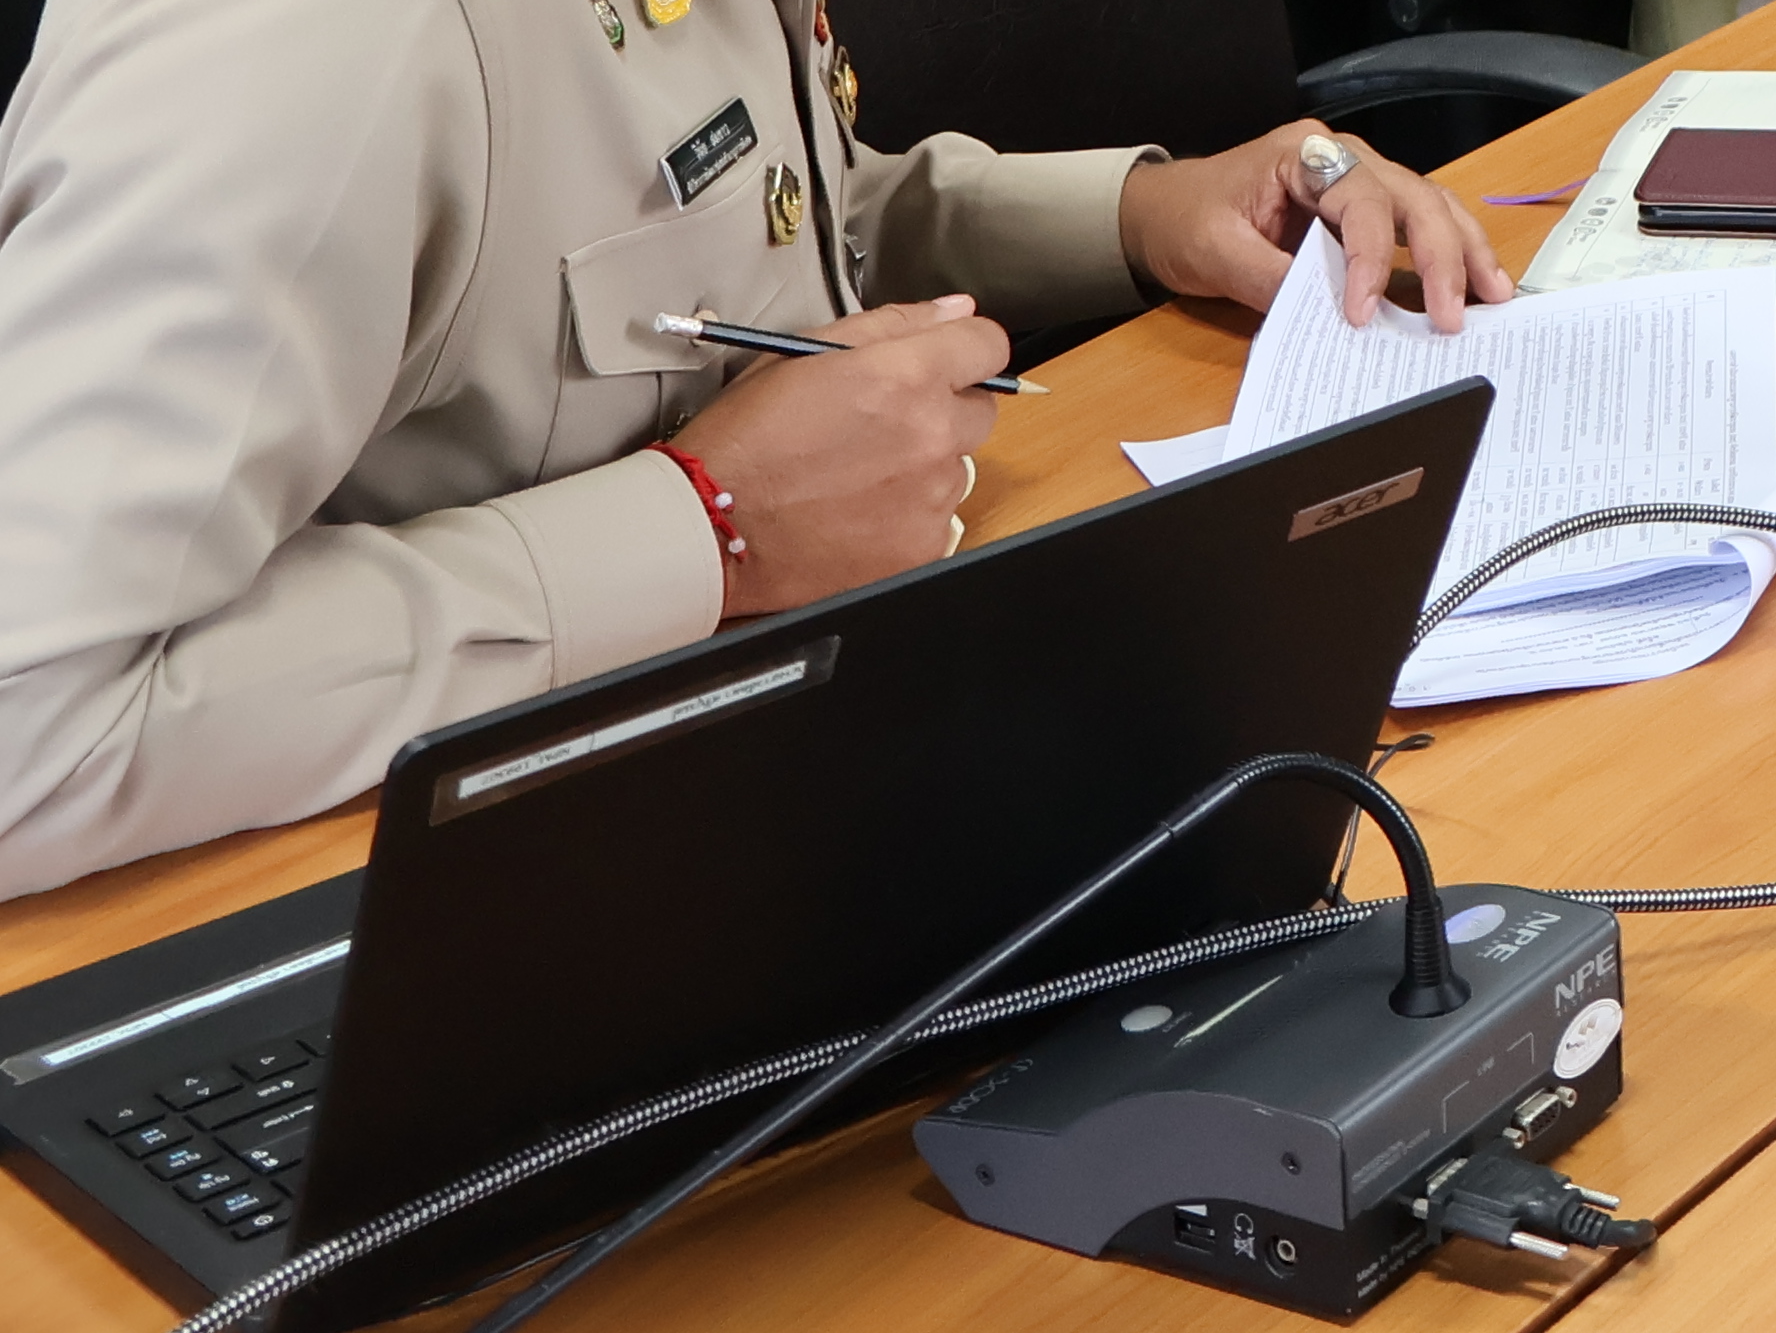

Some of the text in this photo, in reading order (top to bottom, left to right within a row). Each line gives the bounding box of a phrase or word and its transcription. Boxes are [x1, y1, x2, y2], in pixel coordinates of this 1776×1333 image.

[1315, 482, 1400, 526] acer
[1483, 911, 1562, 962] NPE
[1555, 943, 1616, 1010] NPE
